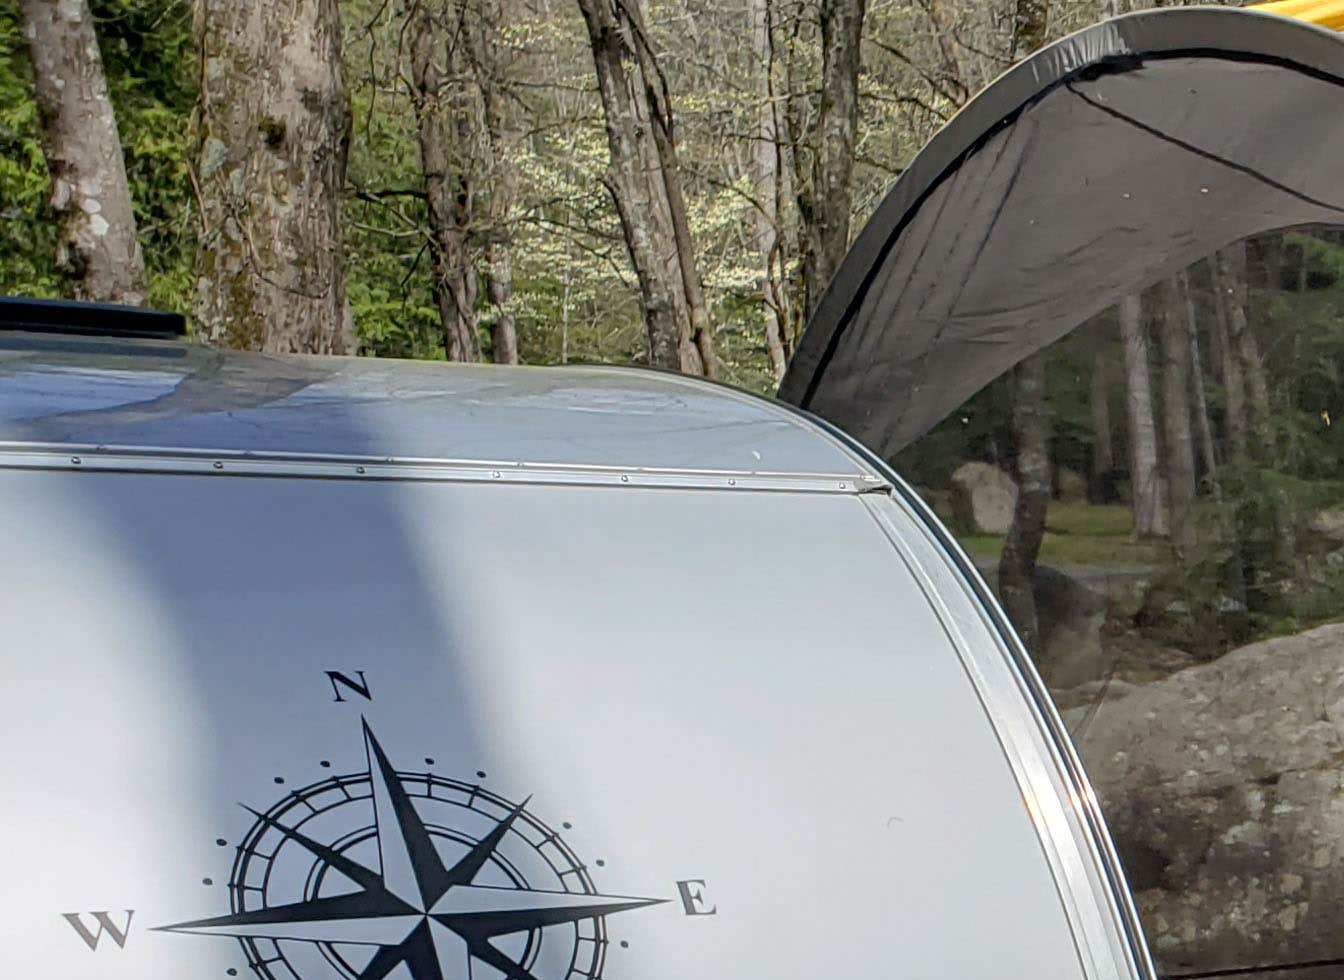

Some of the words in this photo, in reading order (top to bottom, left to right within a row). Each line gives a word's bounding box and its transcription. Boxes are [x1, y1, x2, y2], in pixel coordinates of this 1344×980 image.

[324, 670, 373, 703] N
[677, 879, 717, 916] E
[62, 909, 136, 951] W
